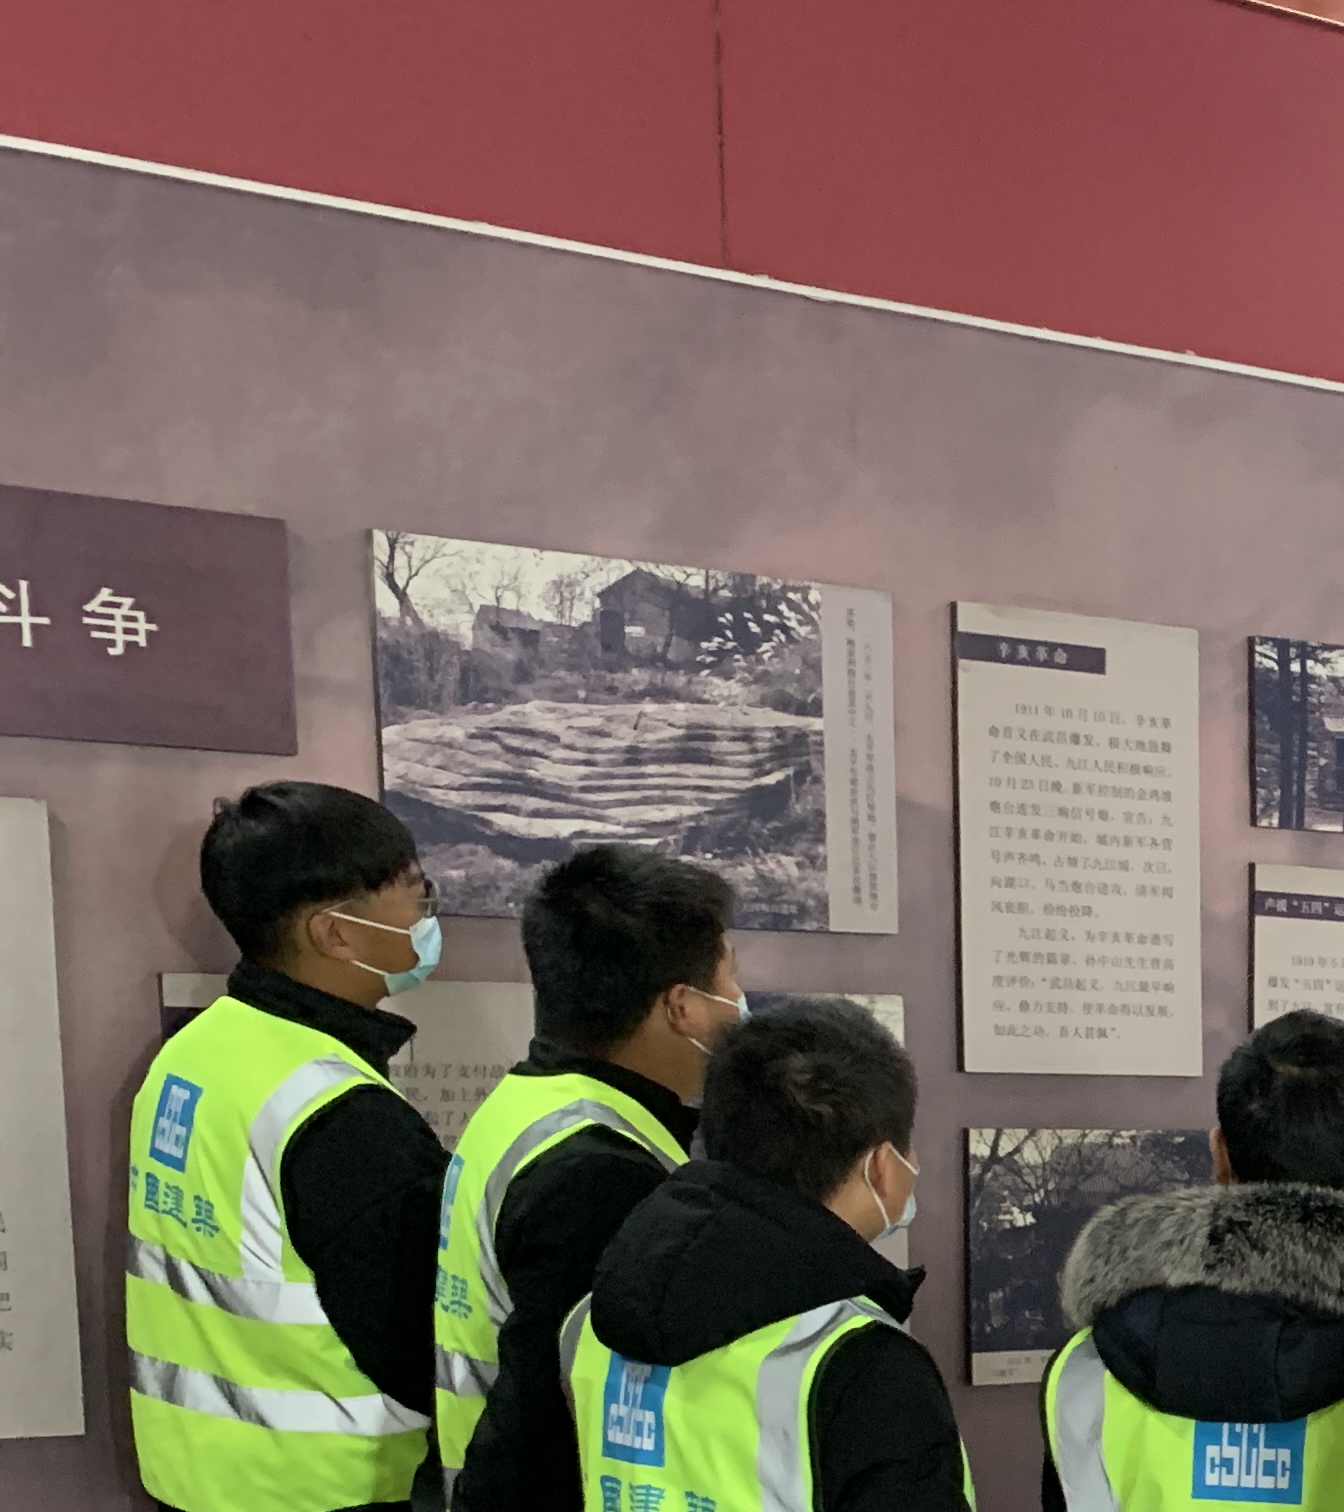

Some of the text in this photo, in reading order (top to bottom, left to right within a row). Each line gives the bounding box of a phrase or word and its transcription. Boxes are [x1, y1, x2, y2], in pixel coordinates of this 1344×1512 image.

[0, 579, 159, 655] 斗争
[997, 641, 1067, 665] 辛亥革命
